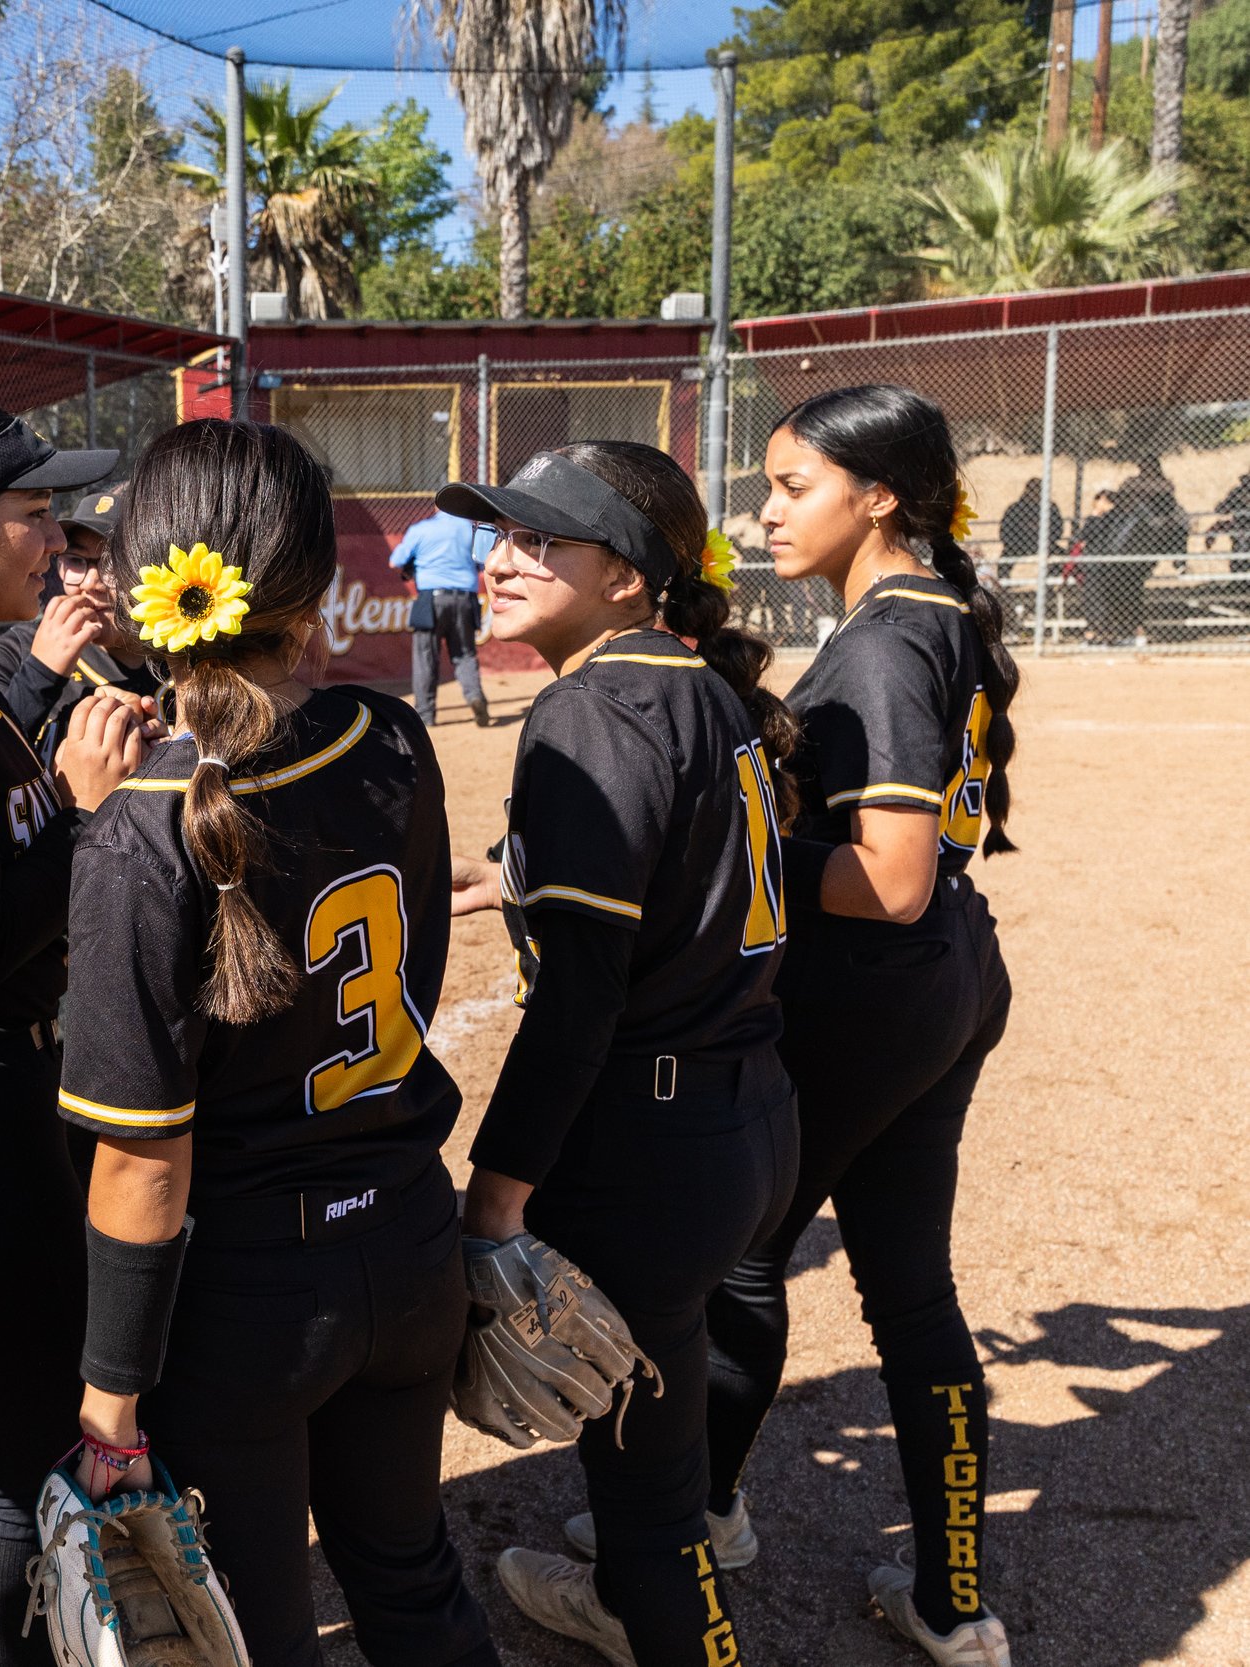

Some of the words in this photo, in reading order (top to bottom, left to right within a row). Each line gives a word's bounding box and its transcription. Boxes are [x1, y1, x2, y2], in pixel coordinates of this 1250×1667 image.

[304, 863, 427, 1115] 3
[680, 1539, 742, 1667] TIG
[932, 1383, 980, 1613] TIGERS
